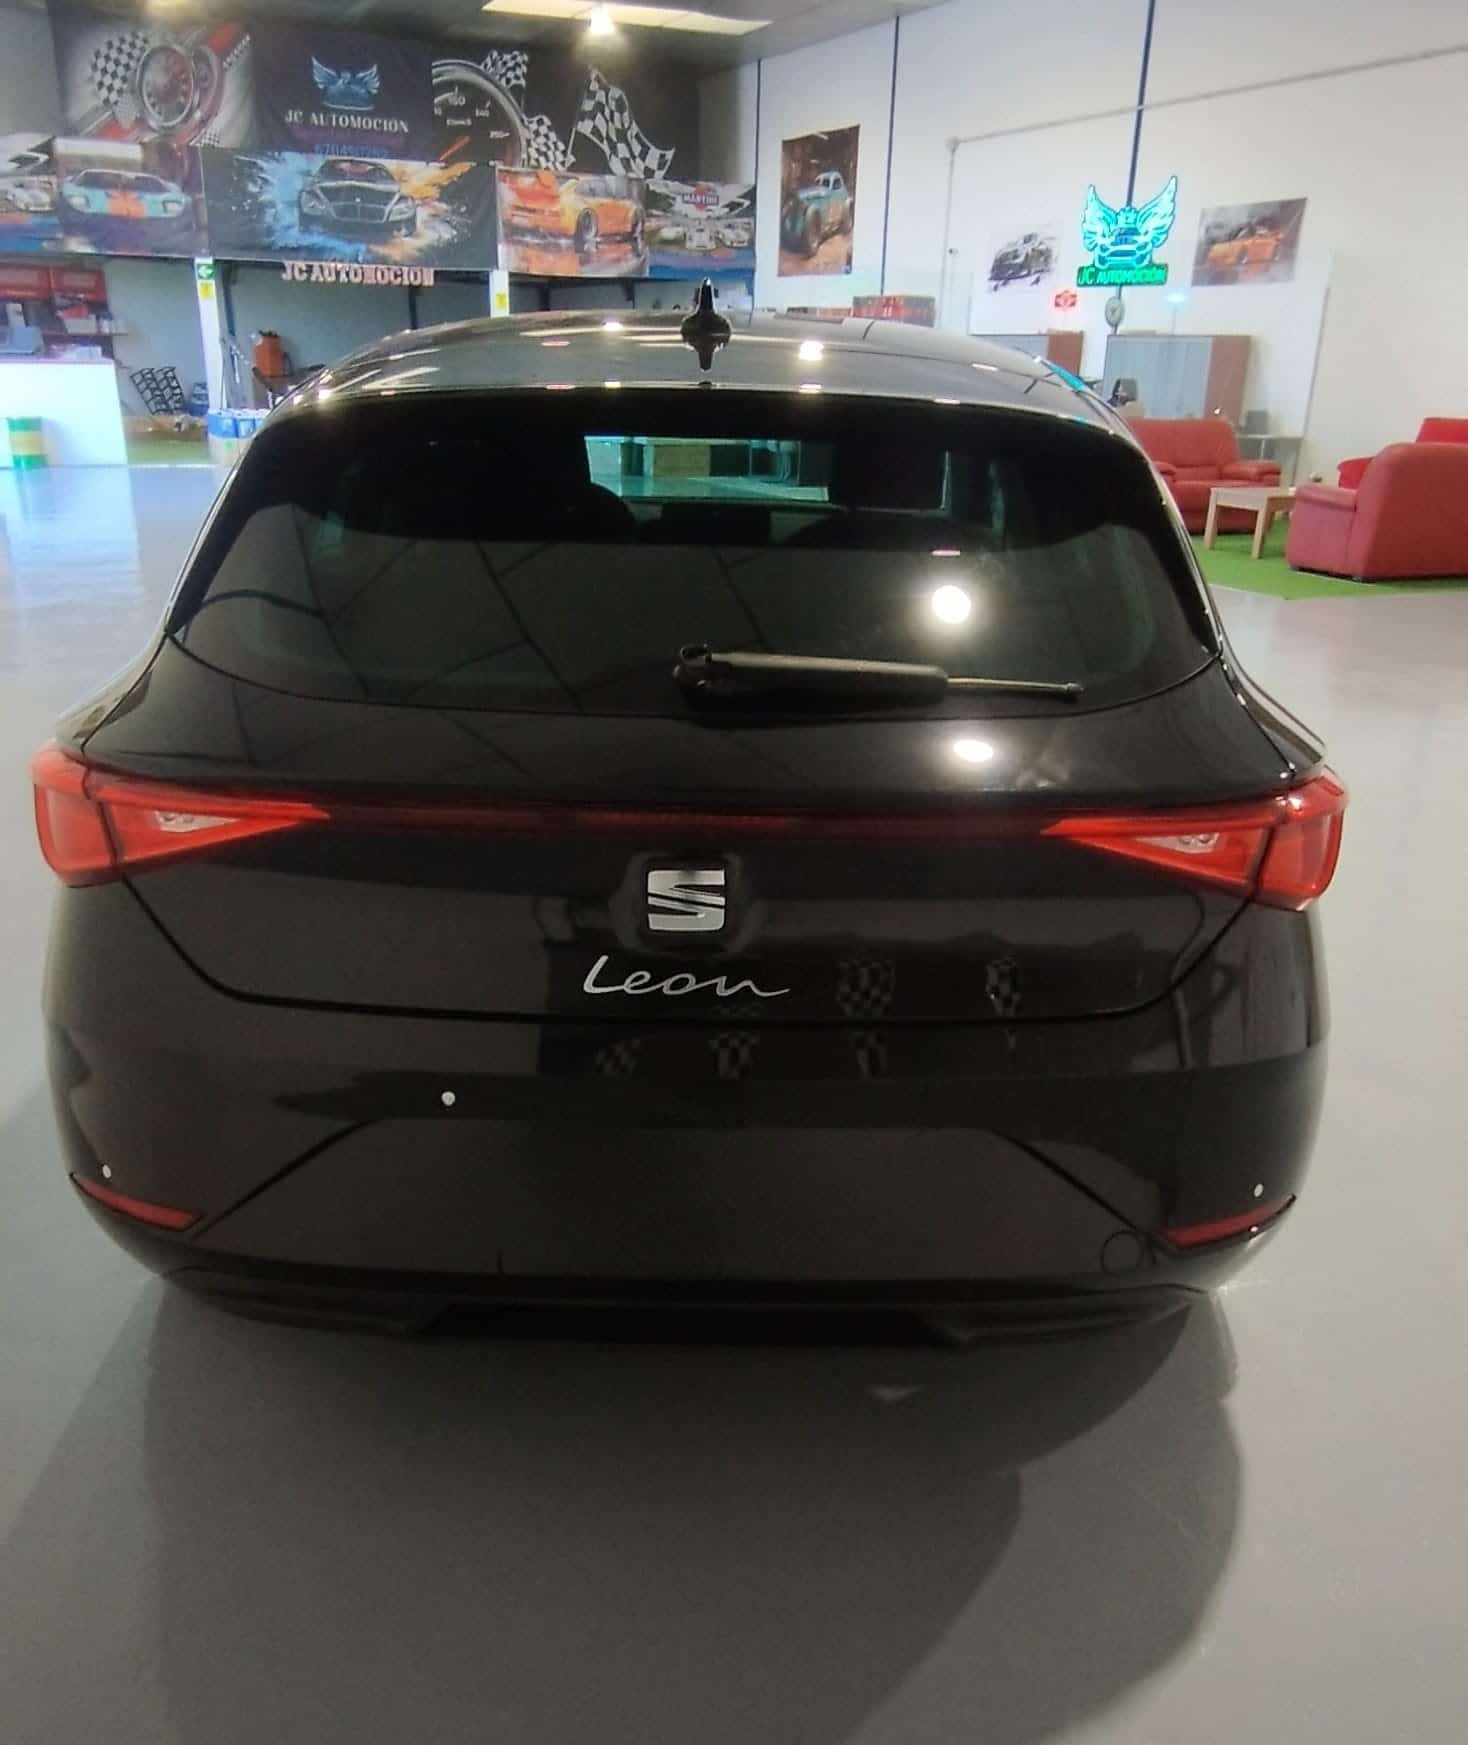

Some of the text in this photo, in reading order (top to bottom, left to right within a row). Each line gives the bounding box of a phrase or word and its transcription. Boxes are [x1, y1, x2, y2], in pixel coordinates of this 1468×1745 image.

[284, 109, 303, 123] JC
[281, 261, 307, 281] JC
[1078, 266, 1096, 285] JC
[583, 954, 791, 998] Leon
